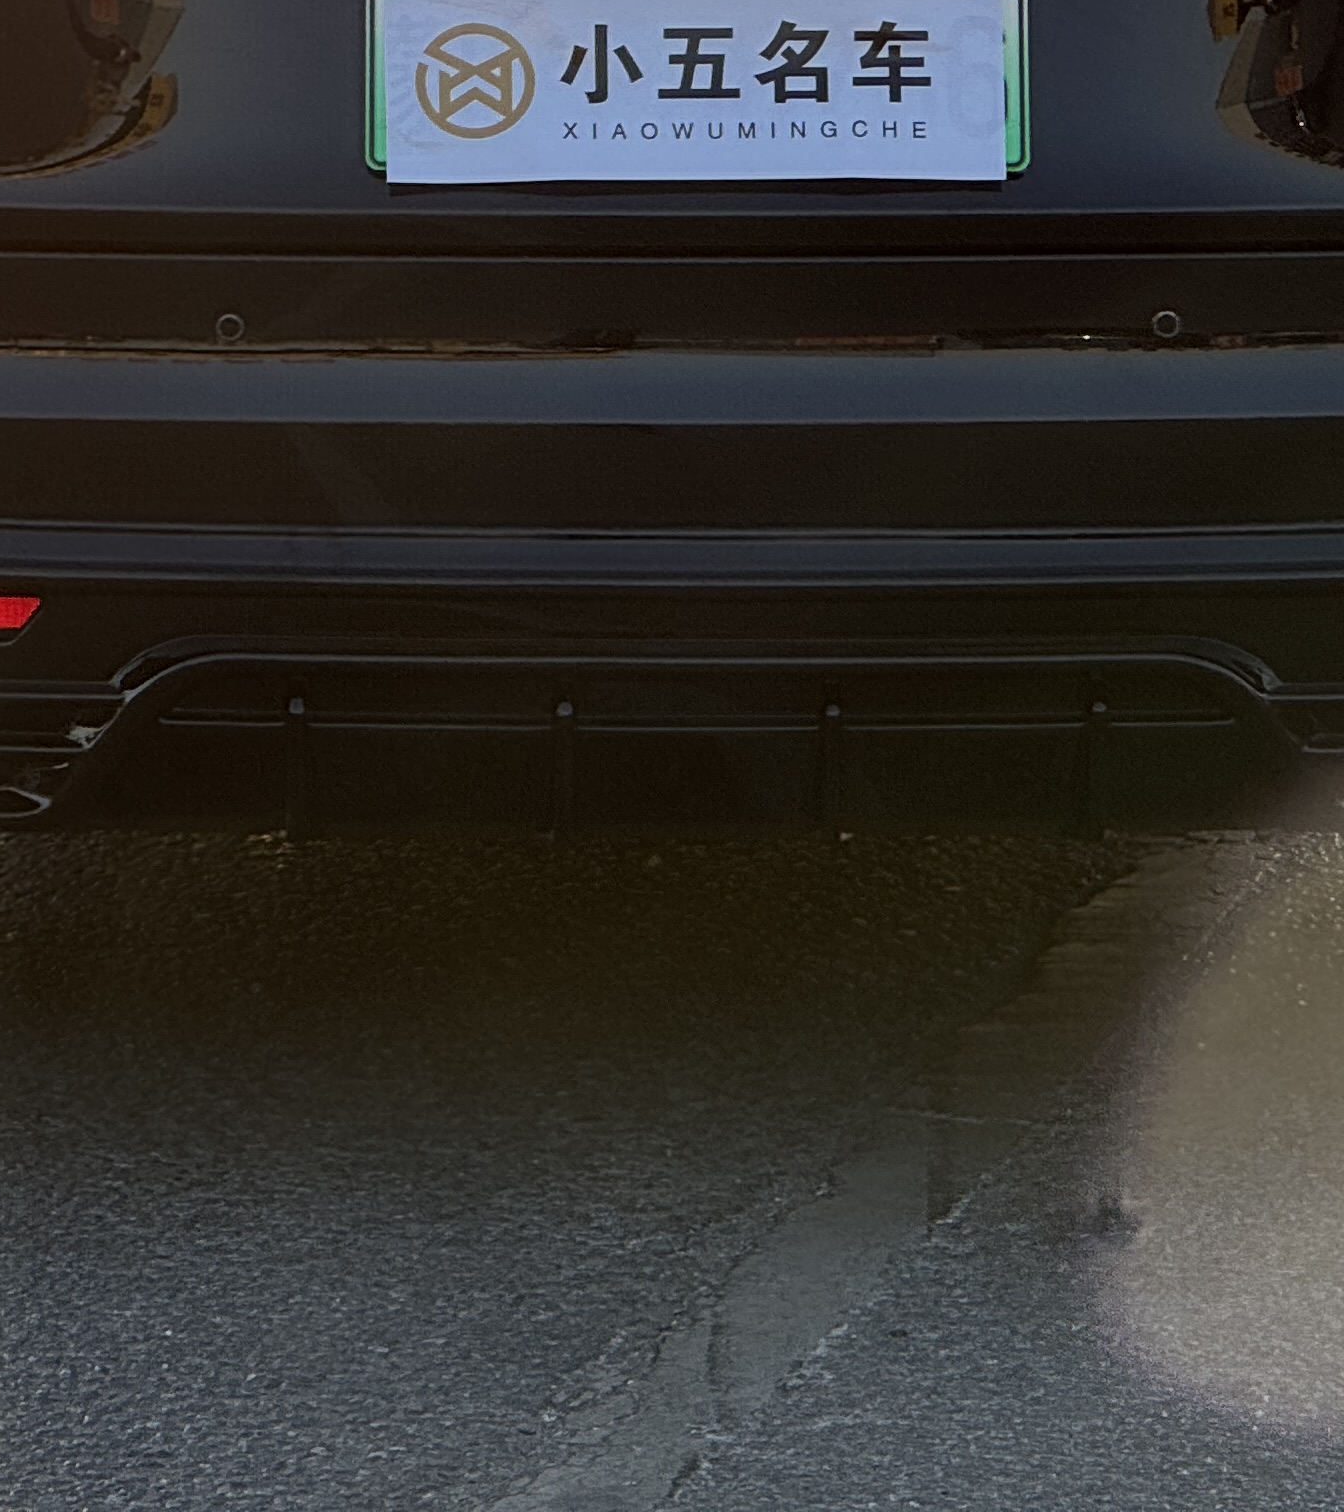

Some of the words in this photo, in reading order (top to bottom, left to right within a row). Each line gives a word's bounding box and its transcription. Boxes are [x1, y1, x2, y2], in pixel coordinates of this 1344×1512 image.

[559, 20, 932, 104] 小五名车
[562, 120, 928, 141] XIAOWUMINGCHE
